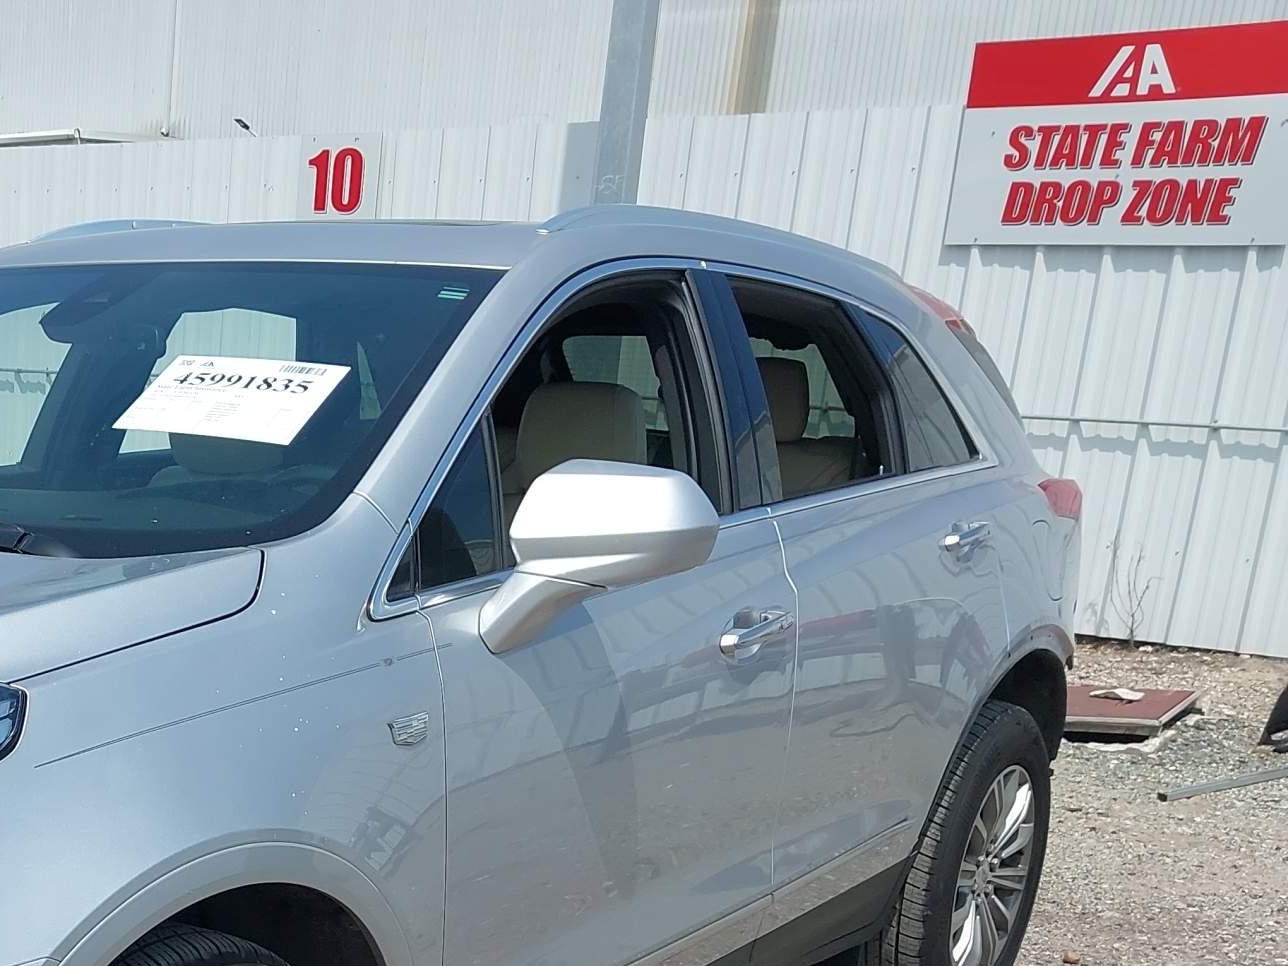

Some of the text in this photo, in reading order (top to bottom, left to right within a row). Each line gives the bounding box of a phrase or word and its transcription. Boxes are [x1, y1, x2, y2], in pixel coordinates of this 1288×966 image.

[1002, 114, 1269, 171] STATE FARM
[308, 146, 365, 215] 10
[1000, 177, 1243, 226] DROP ZONE
[173, 372, 315, 394] 45991835
